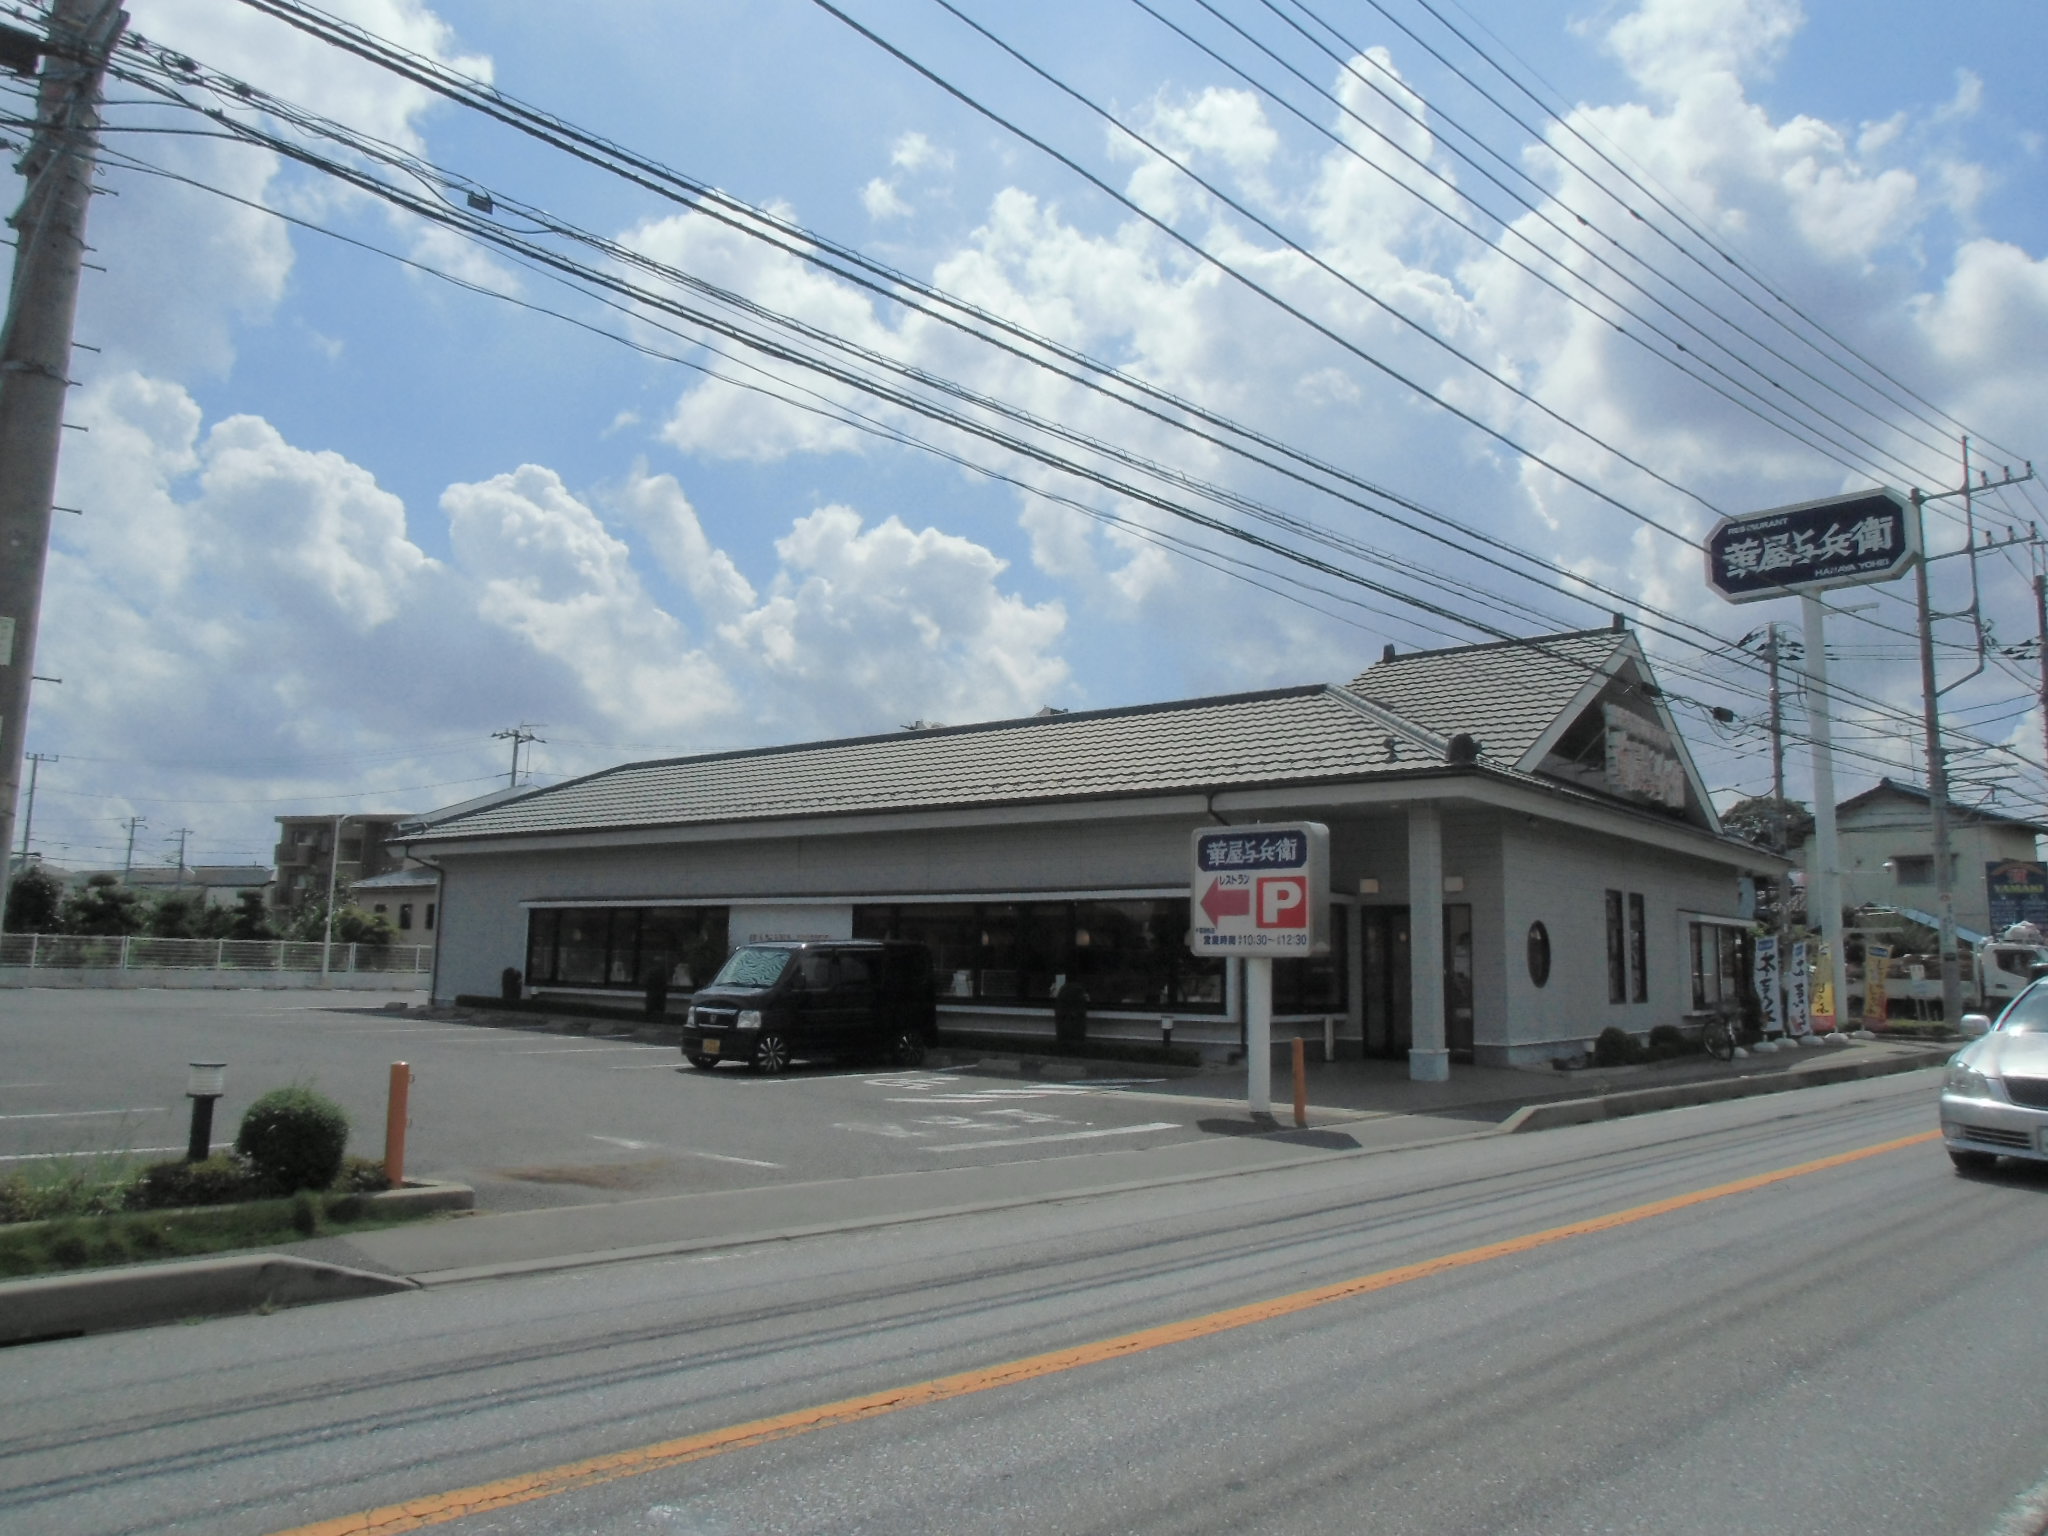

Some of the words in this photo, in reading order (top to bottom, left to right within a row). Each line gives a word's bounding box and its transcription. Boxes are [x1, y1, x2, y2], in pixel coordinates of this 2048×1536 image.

[1207, 838, 1298, 866] 華屋与兵衛
[1219, 874, 1250, 886] レストラン
[1263, 881, 1303, 924] P
[1203, 935, 1236, 946] 営業時間
